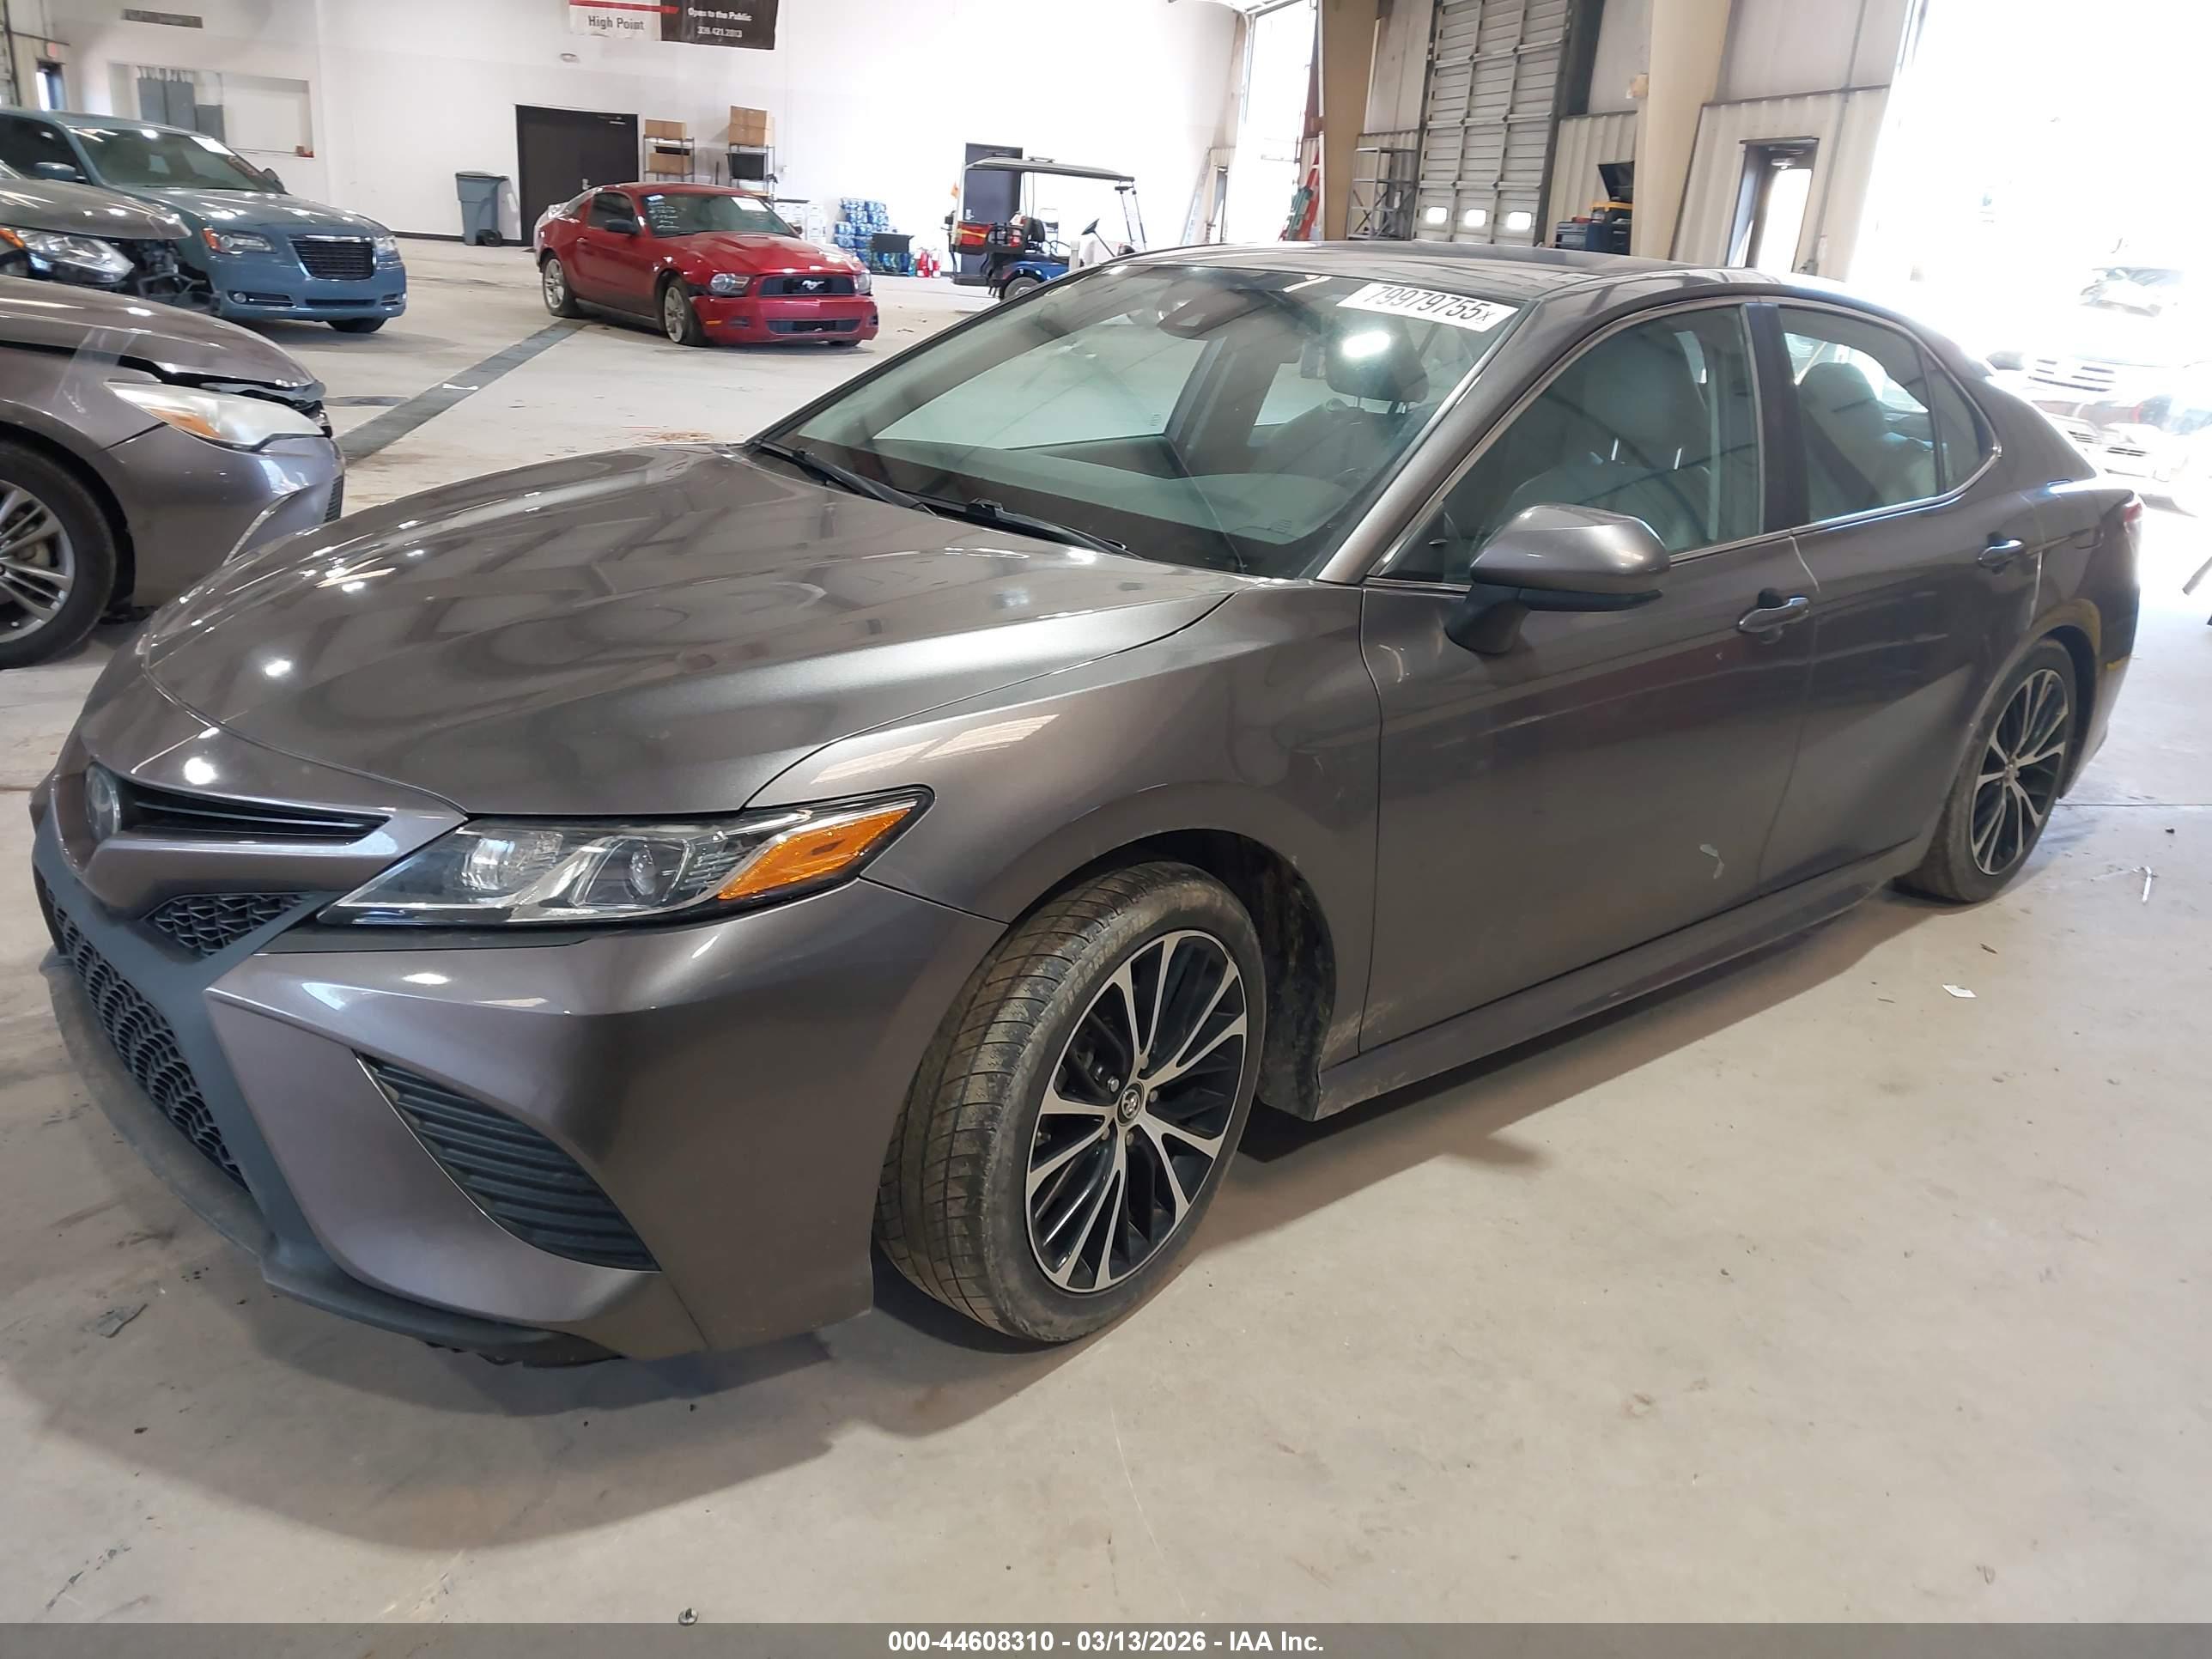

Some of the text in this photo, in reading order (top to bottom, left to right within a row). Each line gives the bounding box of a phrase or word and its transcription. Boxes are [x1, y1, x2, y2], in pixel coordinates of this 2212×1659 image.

[688, 8, 707, 18] Open
[716, 10, 727, 19] the
[728, 11, 752, 21] Public
[588, 15, 645, 30] High Point
